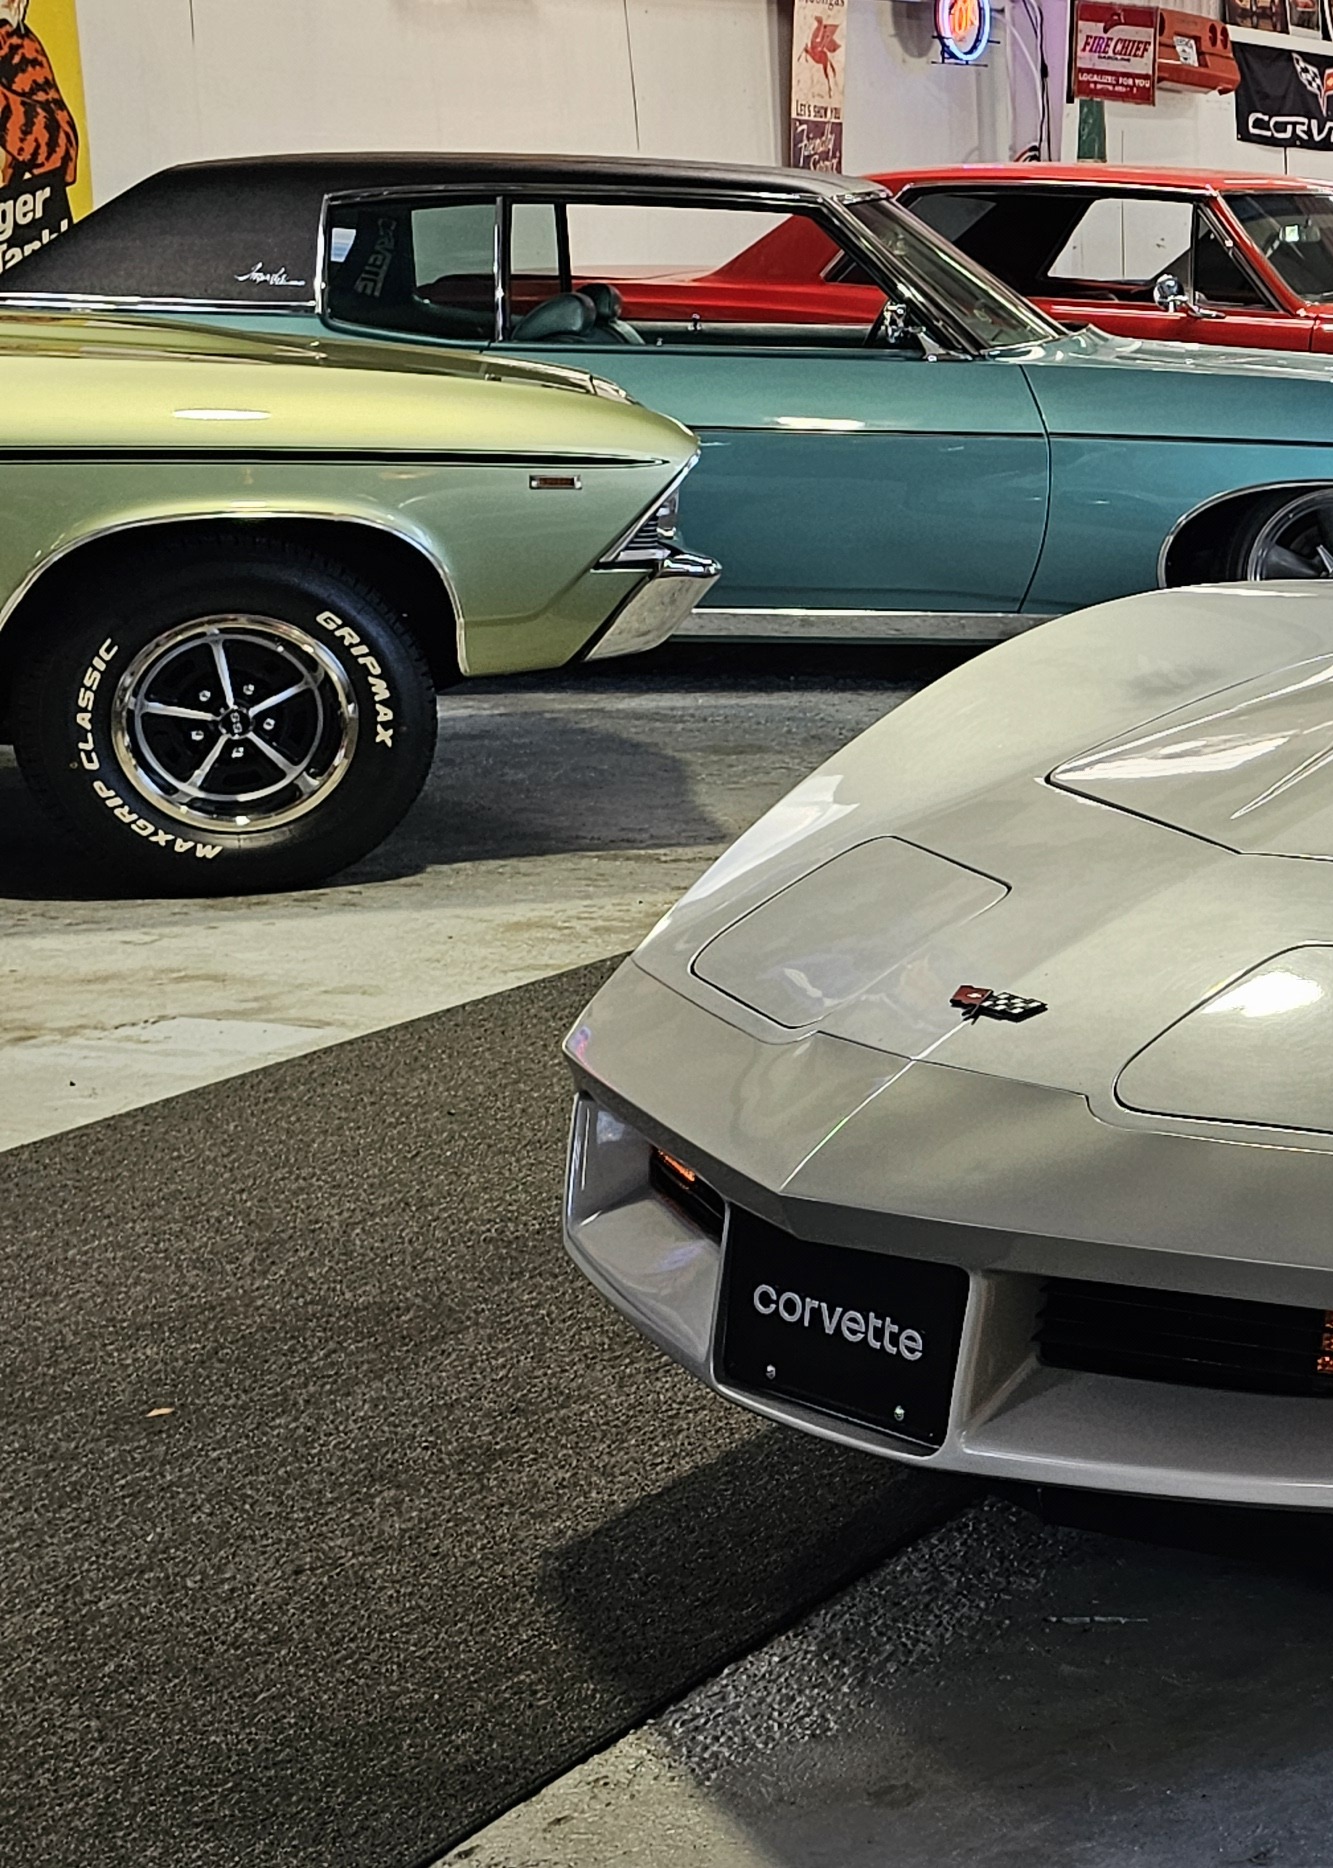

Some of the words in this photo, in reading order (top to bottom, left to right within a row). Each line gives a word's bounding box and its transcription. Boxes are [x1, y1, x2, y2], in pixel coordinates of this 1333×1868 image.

[1082, 34, 1111, 54] FIRE
[1112, 37, 1151, 59] CHIEF
[75, 638, 118, 771] CLASSIC
[315, 610, 395, 748] GRIPMAX
[93, 780, 223, 860] MAXGRIP
[753, 1284, 923, 1361] corvette
